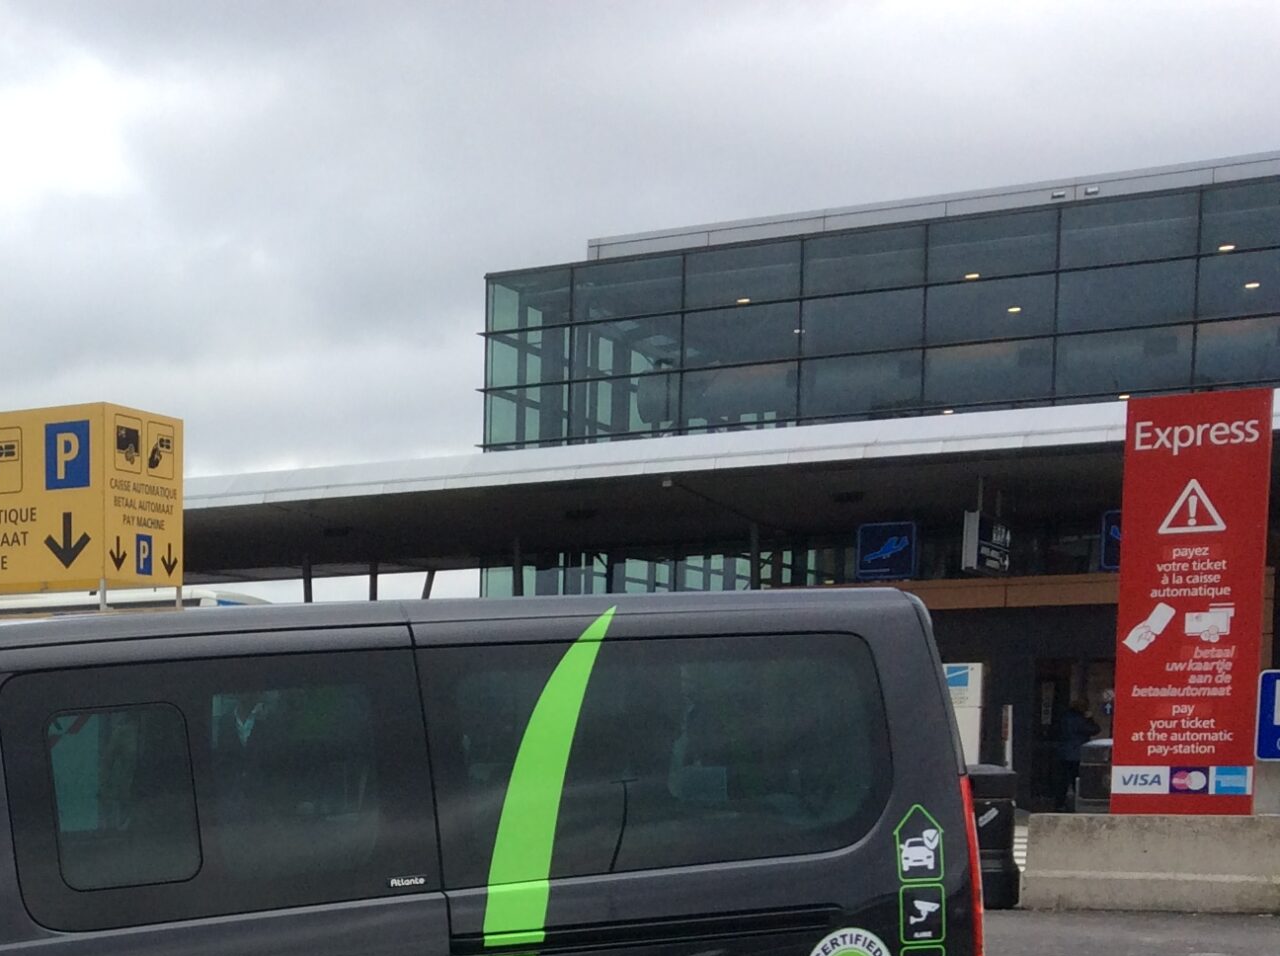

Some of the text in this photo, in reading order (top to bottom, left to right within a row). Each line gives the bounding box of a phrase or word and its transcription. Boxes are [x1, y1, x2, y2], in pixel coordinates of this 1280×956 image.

[1135, 418, 1260, 455] Express
[56, 432, 79, 480] P
[110, 477, 177, 500] CAISSE AUTOMATIQUE
[114, 496, 173, 516] BETAAL AUTOMAAT
[123, 514, 165, 531] PAY MACHINE
[139, 540, 149, 569] P
[1172, 546, 1209, 559] payez
[1156, 559, 1227, 572] votre ticket
[1161, 572, 1221, 585] à la caisse
[1150, 585, 1231, 599] automatique
[1193, 645, 1236, 659] betaal
[1166, 659, 1233, 674] uw kaartje
[1188, 672, 1233, 683] aan de
[1131, 684, 1232, 697] betaalautomaat
[1172, 704, 1195, 716] pay
[1150, 717, 1216, 730] your ticket
[1131, 730, 1234, 741] at the automatic
[1147, 742, 1215, 756] pay-station
[1122, 773, 1162, 786] VISA
